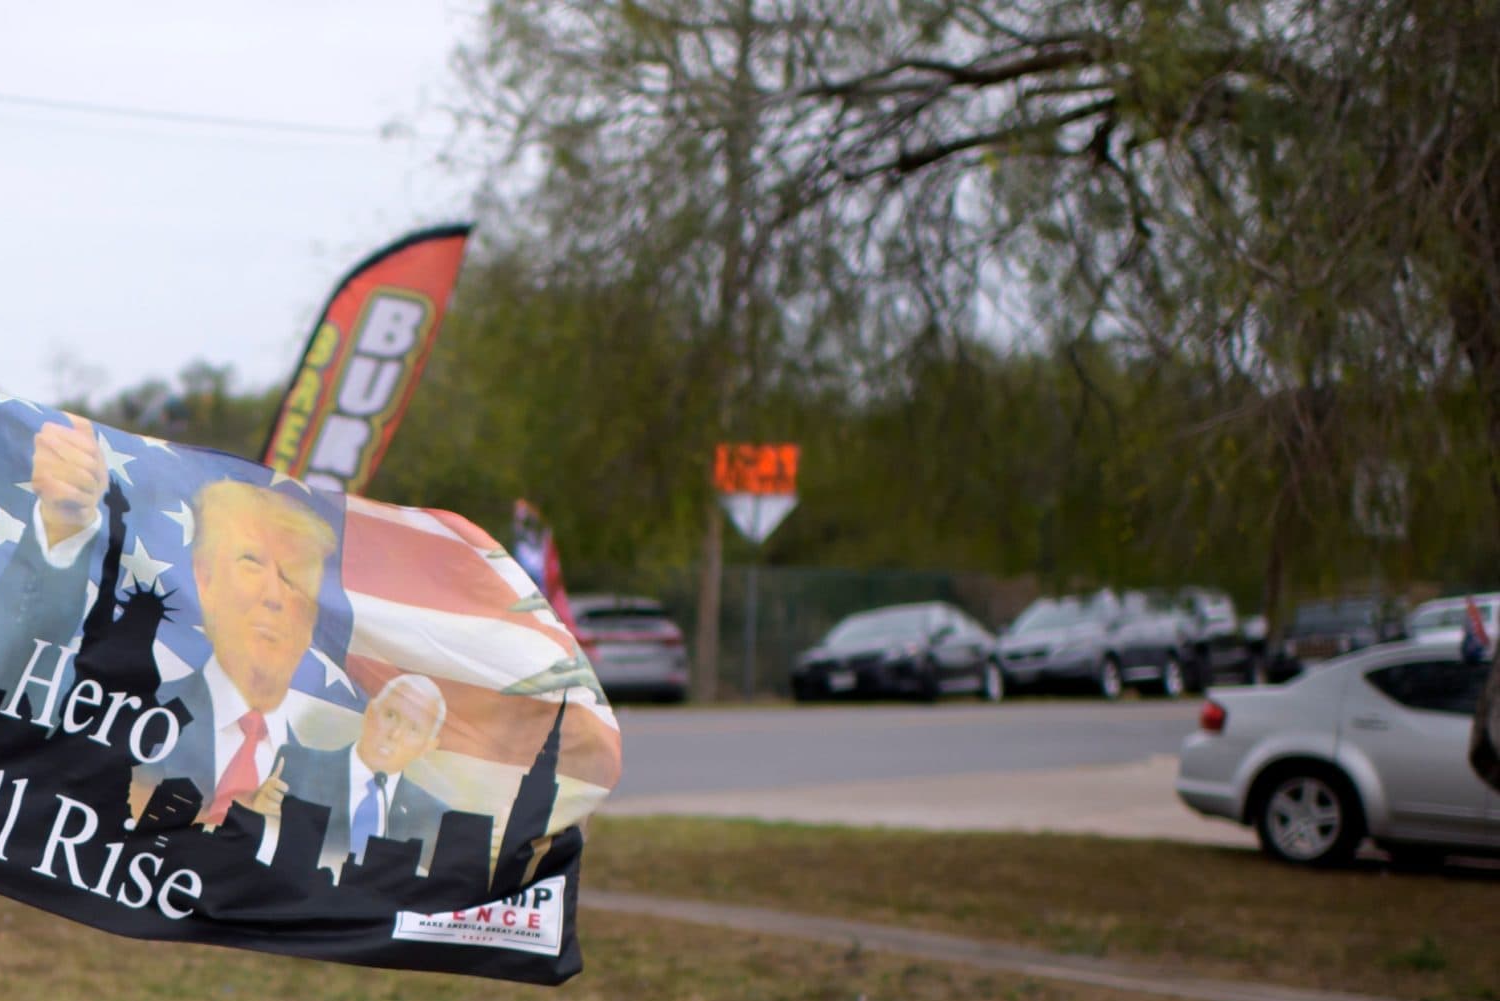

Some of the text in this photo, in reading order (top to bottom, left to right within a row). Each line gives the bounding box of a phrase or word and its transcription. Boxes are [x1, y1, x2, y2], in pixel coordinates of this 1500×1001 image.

[0, 638, 180, 764] Hero
[31, 793, 203, 919] Rise
[419, 920, 541, 939] MAKE AMERICA GREAT AGAIN
[426, 907, 541, 930] ENCE
